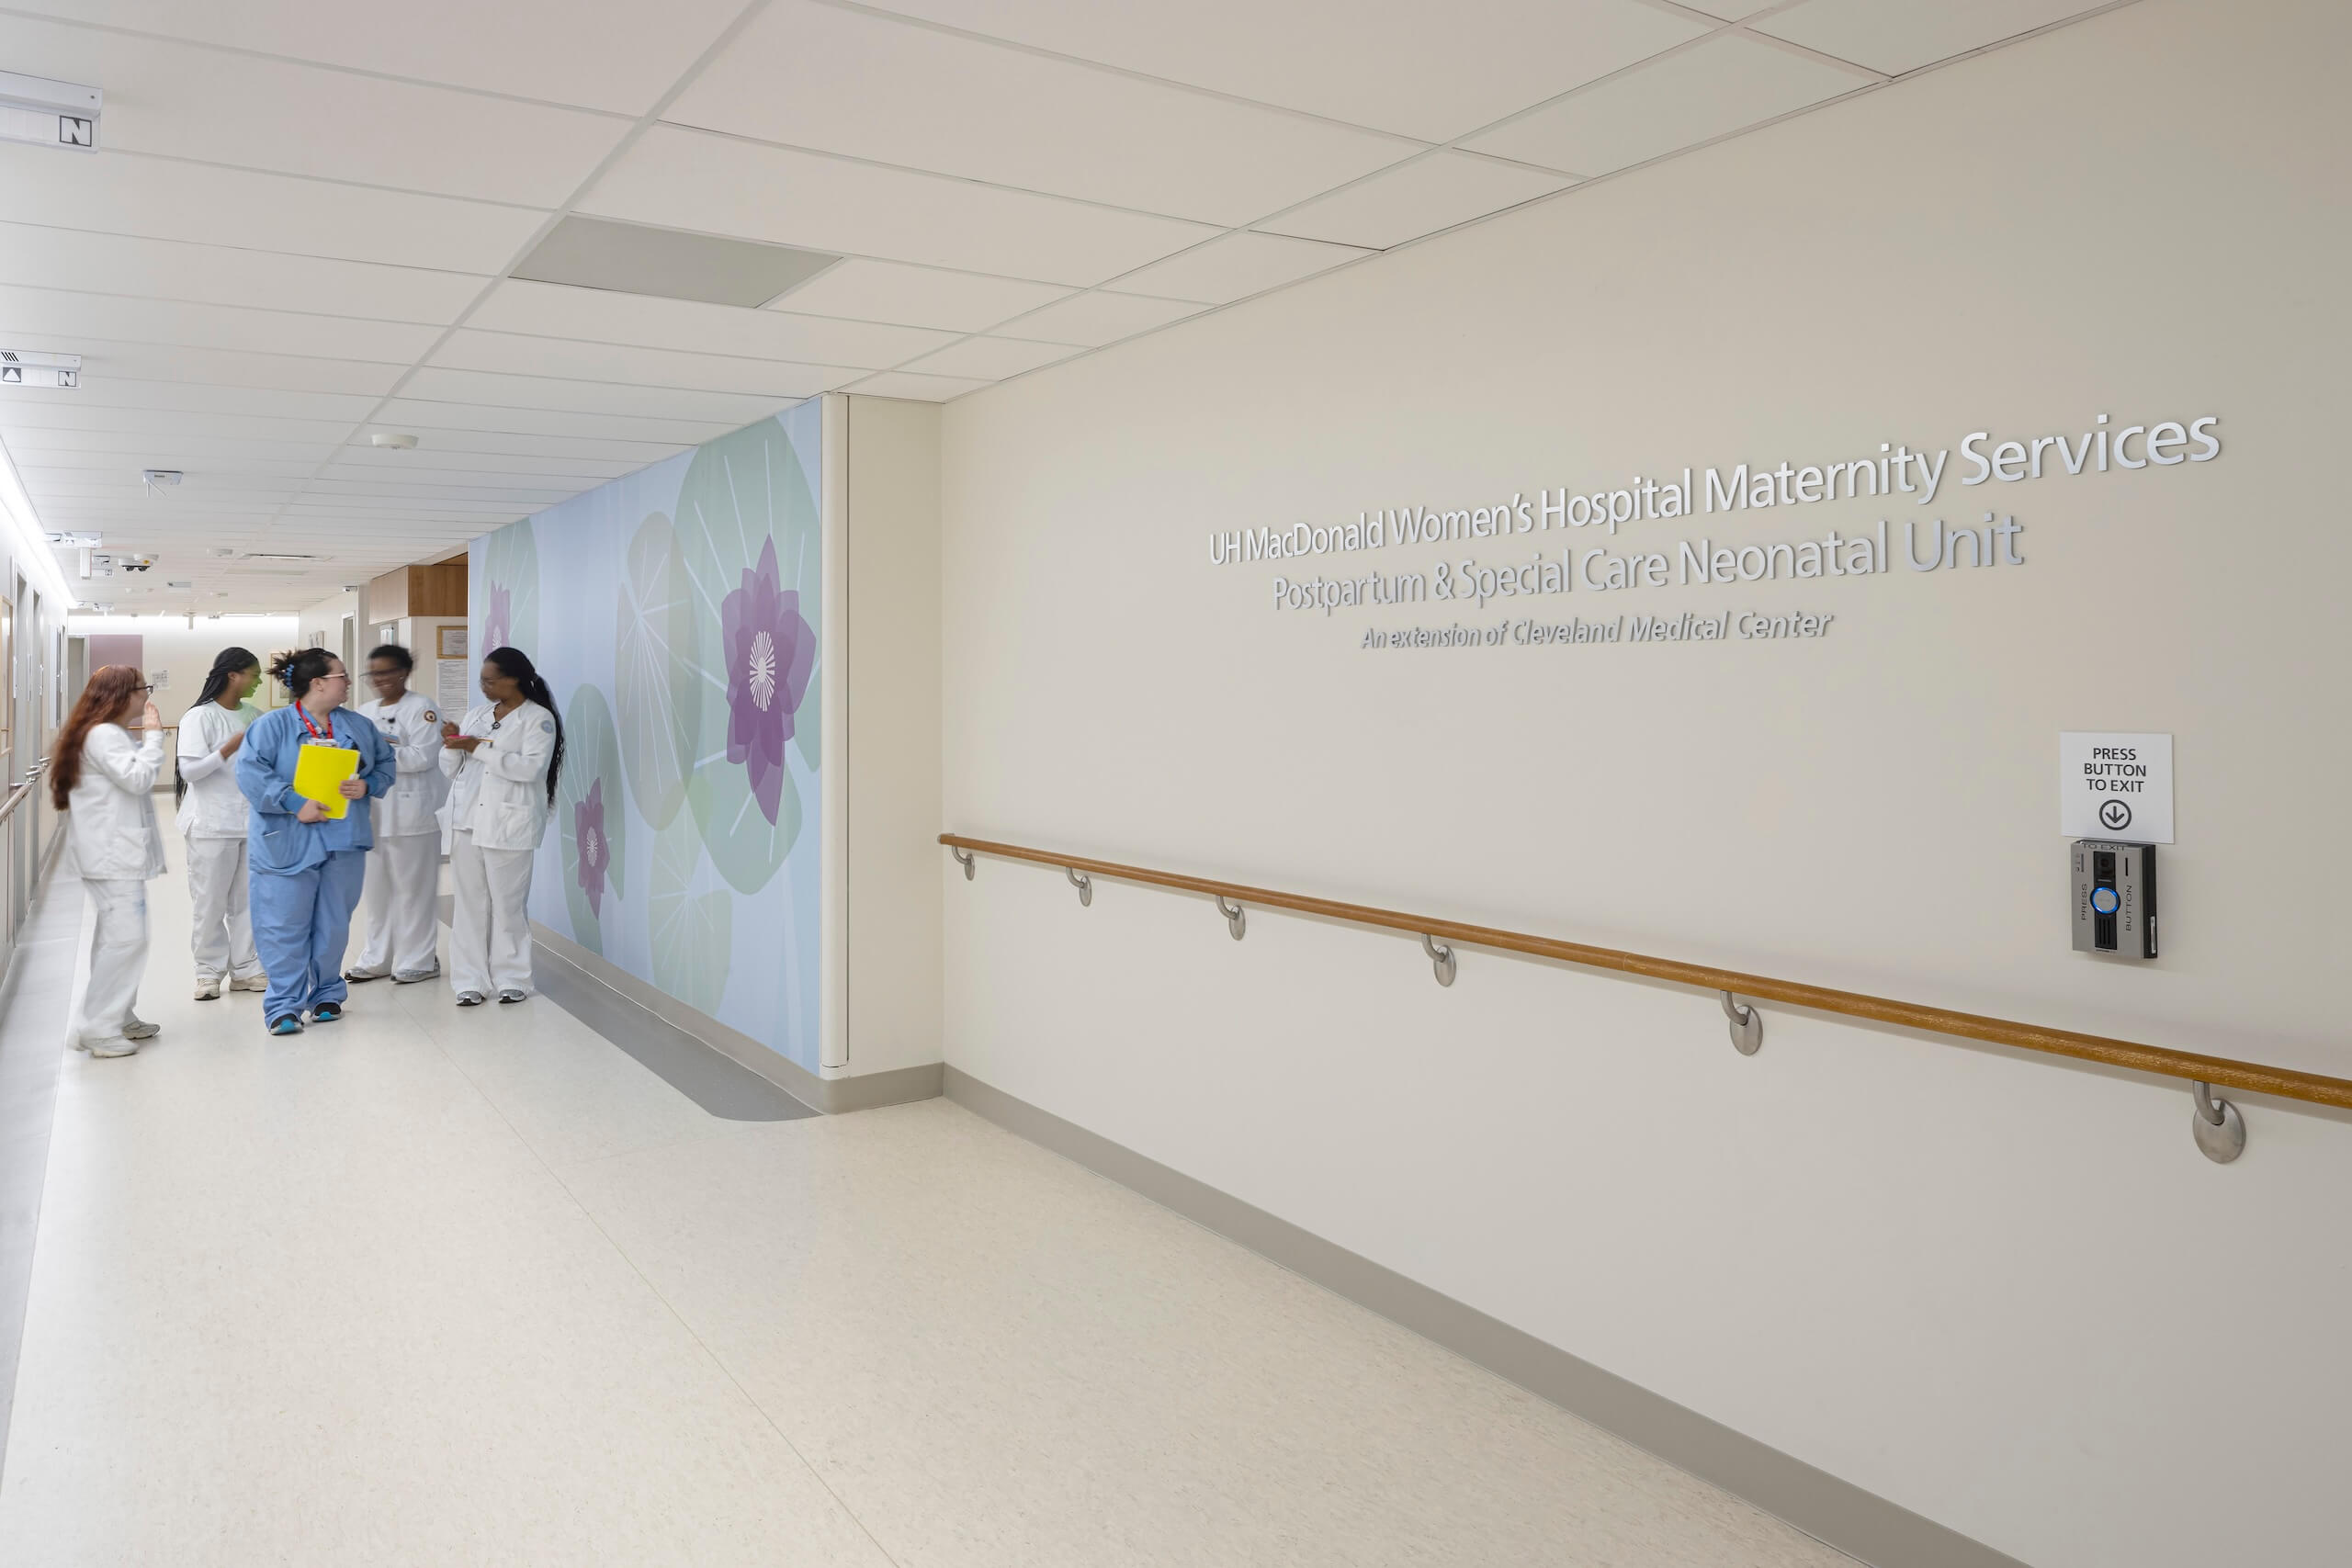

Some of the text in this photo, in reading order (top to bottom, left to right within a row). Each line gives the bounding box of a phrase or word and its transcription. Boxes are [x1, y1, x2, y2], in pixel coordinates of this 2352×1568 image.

[1210, 413, 2221, 565] UH MacDonald Women’s Hospital Maternity Services
[1272, 512, 2025, 616] Postpartum & Special Care Neonatal Unit
[1361, 610, 1836, 649] An extension of Cleveland Medical Center
[2093, 747, 2137, 761] PRESS
[2084, 762, 2146, 777] BUTTON
[2086, 778, 2144, 793] TO EXIT
